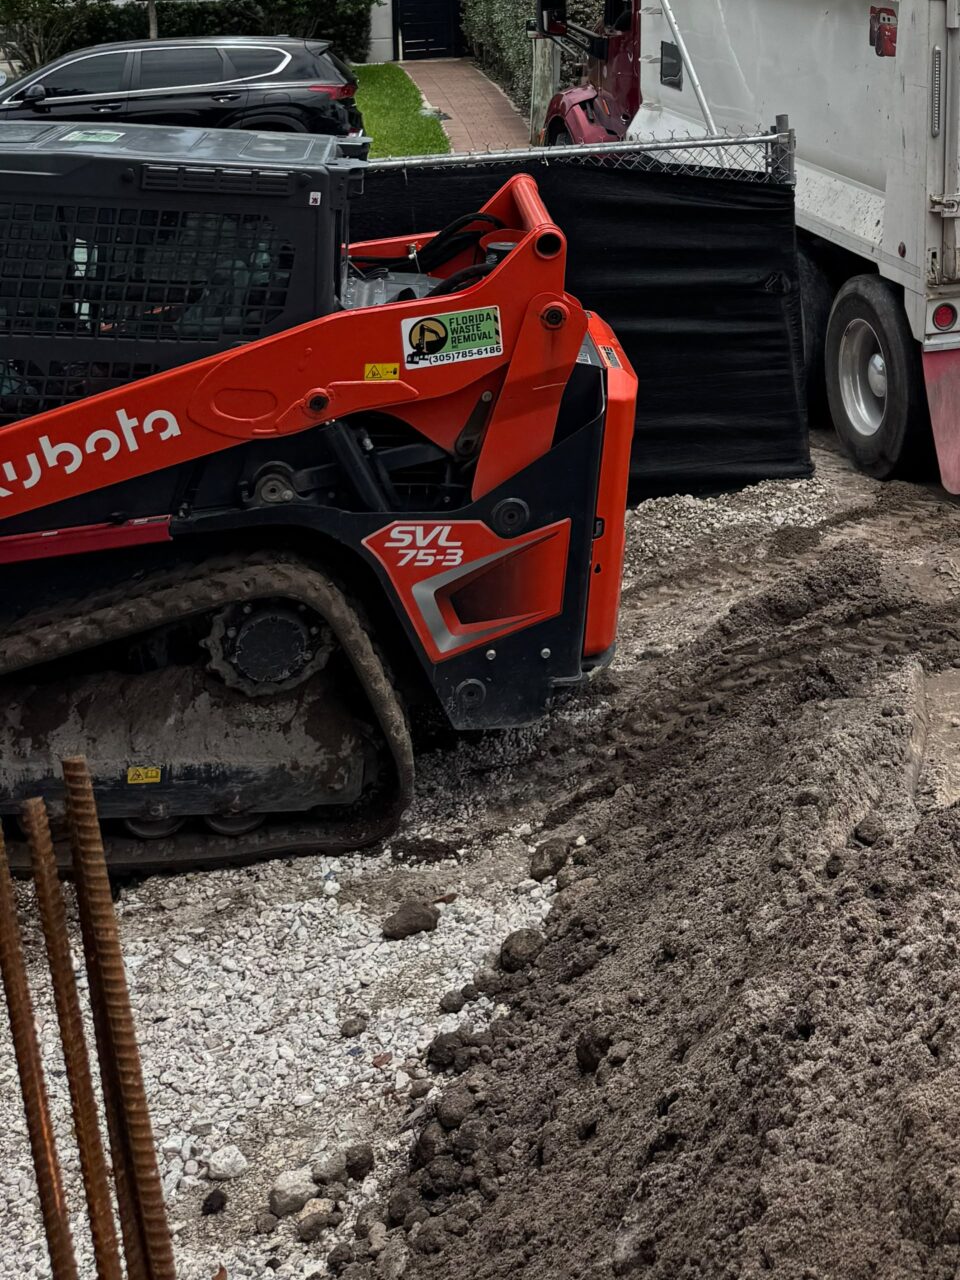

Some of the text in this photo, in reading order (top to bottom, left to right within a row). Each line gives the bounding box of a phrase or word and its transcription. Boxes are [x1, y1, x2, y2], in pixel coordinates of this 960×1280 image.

[449, 312, 492, 327] FLORIDA
[450, 323, 481, 335] WASTE
[451, 331, 494, 345] REMOVAL
[429, 346, 502, 365] (305)785-6186
[384, 525, 462, 547] SVL
[396, 549, 464, 567] 75-3
